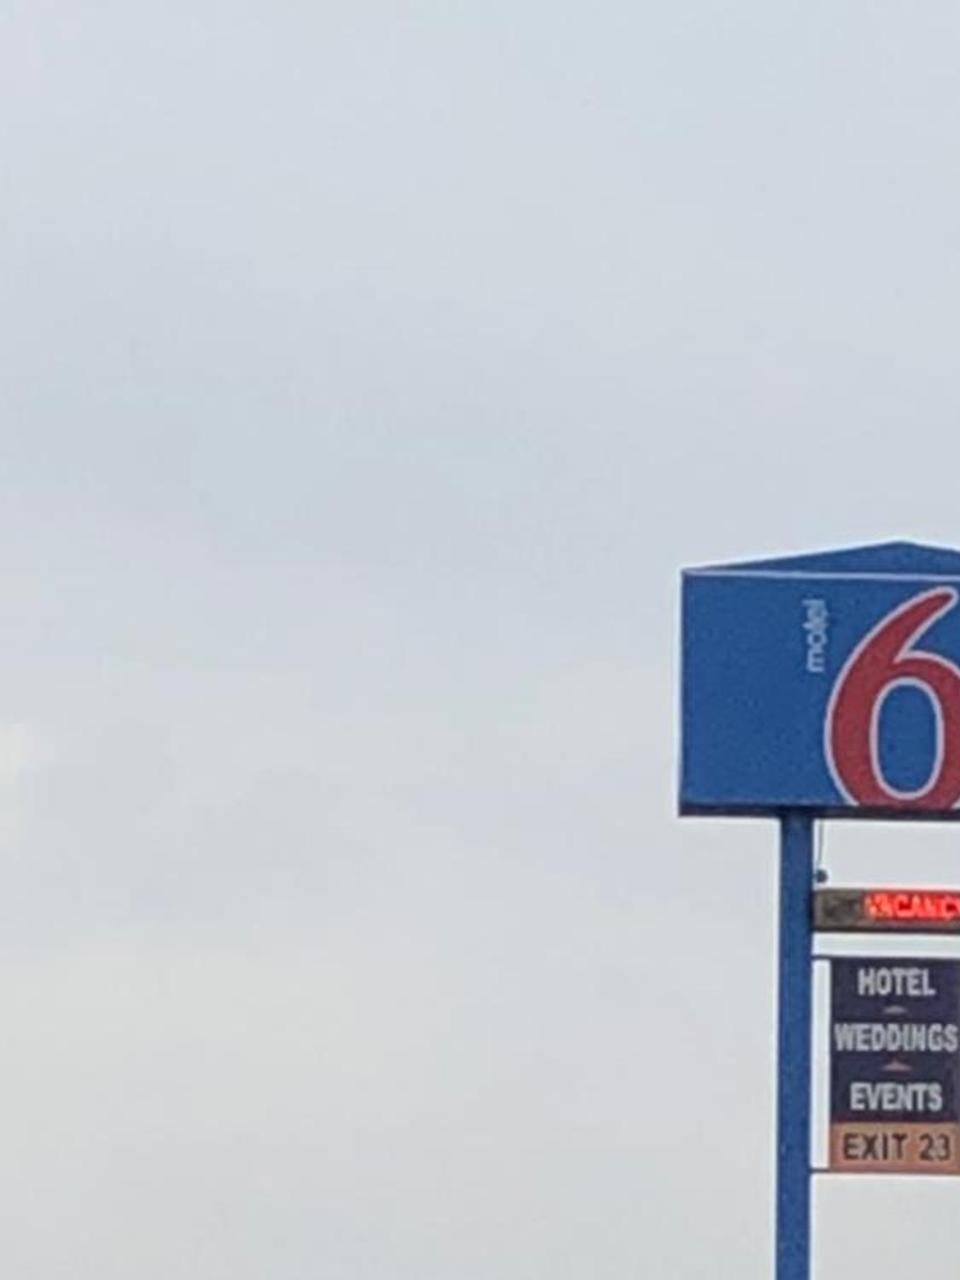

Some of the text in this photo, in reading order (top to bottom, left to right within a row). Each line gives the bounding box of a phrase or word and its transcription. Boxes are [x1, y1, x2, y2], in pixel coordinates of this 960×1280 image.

[801, 599, 828, 672] motel
[857, 967, 936, 996] HOTEL
[834, 1022, 959, 1052] WEDDINGS
[849, 1082, 943, 1112] EVENTS
[842, 1131, 951, 1161] EXIT 23
